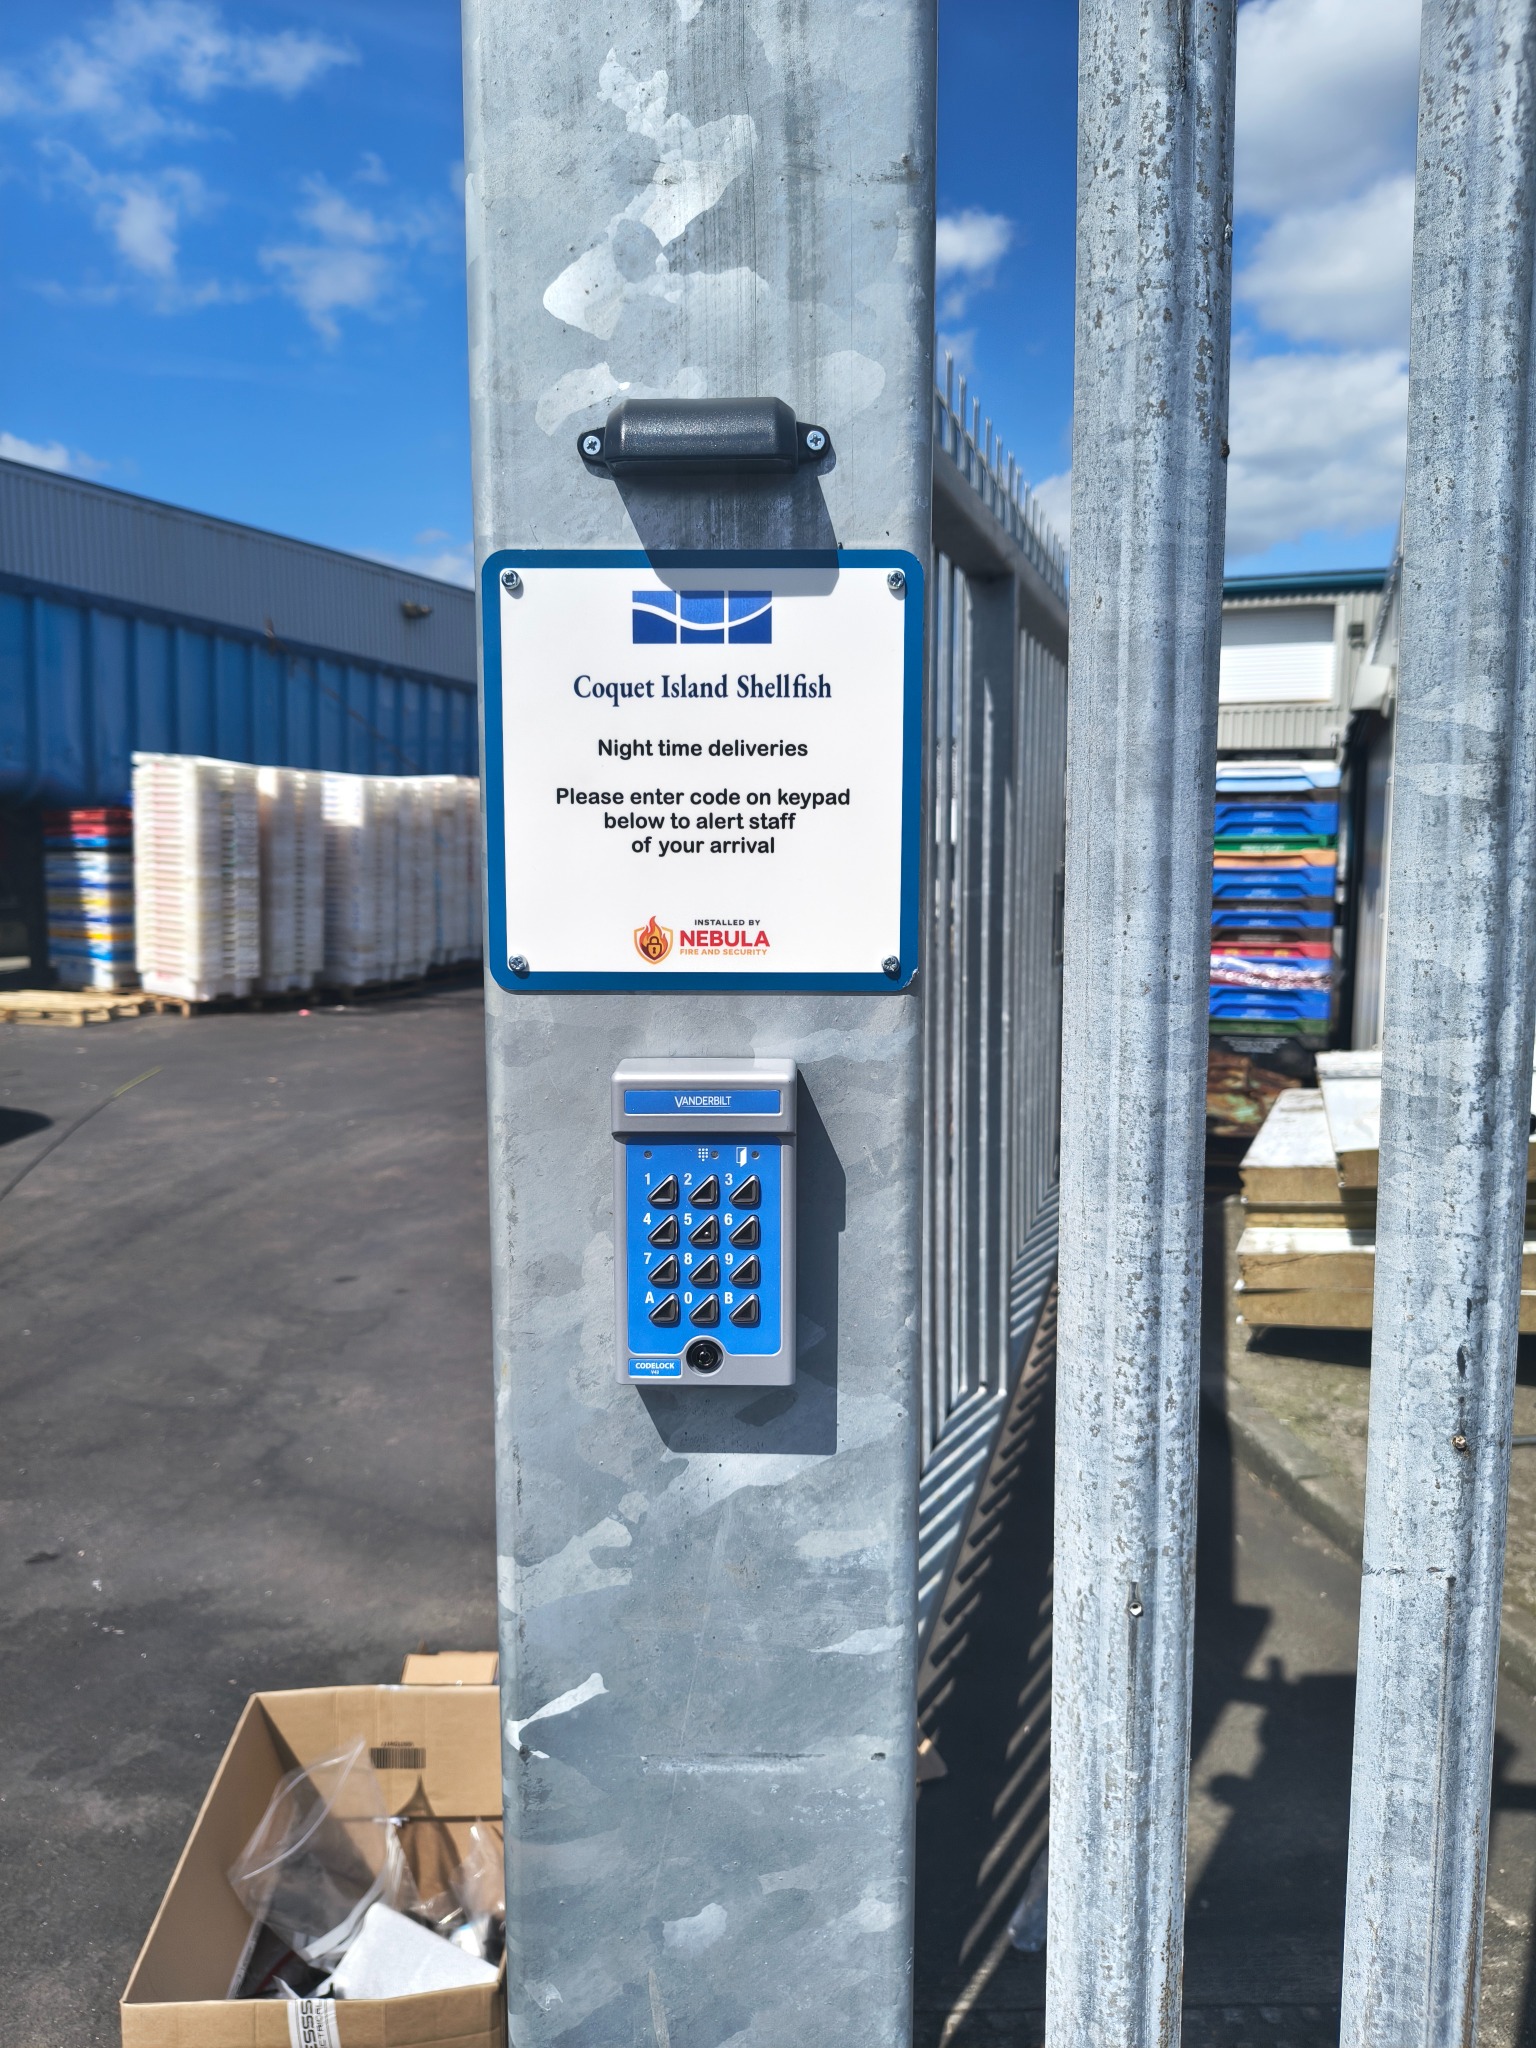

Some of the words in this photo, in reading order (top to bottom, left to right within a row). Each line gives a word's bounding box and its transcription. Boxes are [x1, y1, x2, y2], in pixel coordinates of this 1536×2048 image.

[574, 675, 654, 707] Coquet
[662, 674, 728, 698] Island
[737, 674, 831, 698] Shellfish
[599, 739, 653, 760] Night
[658, 740, 702, 756] time
[709, 740, 808, 756] deliveries
[557, 788, 624, 804] Please
[630, 789, 684, 805] enter
[690, 788, 740, 805] code
[747, 793, 770, 805] on
[778, 789, 850, 809] keypad
[605, 812, 665, 829] below
[670, 813, 690, 829] to
[696, 813, 744, 829] alert
[749, 813, 796, 829] staff
[632, 836, 652, 853] of
[659, 841, 704, 857] your
[710, 837, 774, 853] arrival
[680, 930, 770, 947] NEBULA
[675, 1096, 731, 1107] VANDERBILT
[645, 1173, 650, 1185] 1
[684, 1173, 692, 1185] 2
[725, 1173, 732, 1185] 3
[643, 1213, 651, 1225] 4
[684, 1213, 692, 1225] 5
[724, 1213, 732, 1225] 6
[644, 1252, 651, 1264] 7
[684, 1253, 692, 1264] 8
[725, 1253, 733, 1265] 9
[645, 1292, 654, 1303] A
[725, 1292, 733, 1304] B
[635, 1362, 675, 1370] CODELOCK
